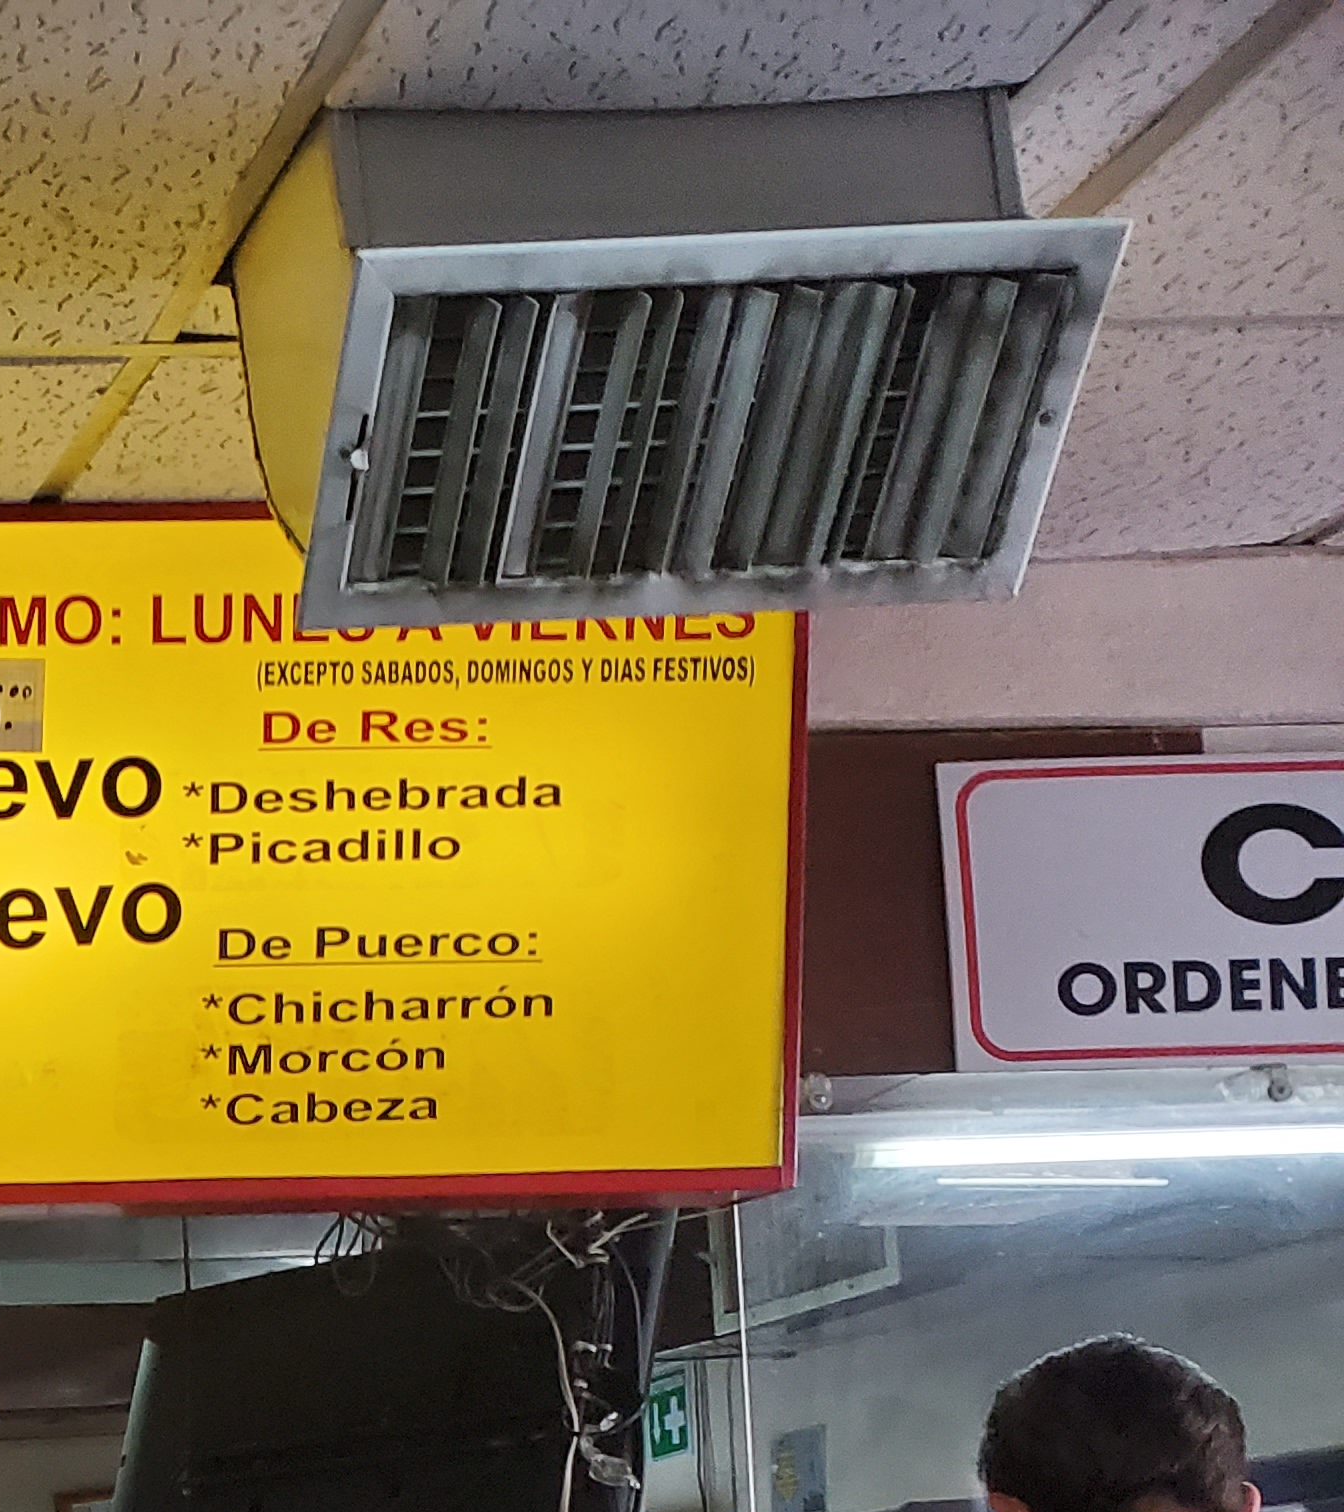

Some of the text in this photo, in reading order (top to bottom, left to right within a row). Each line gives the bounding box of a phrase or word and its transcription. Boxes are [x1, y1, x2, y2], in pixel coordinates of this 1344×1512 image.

[151, 593, 367, 645] LUN
[258, 656, 754, 691] (EXCEPTO SABADOS, DOMINGOS Y DIAS FESTIVOS)
[263, 711, 486, 743] De Res:
[219, 927, 537, 960] De Puerco:
